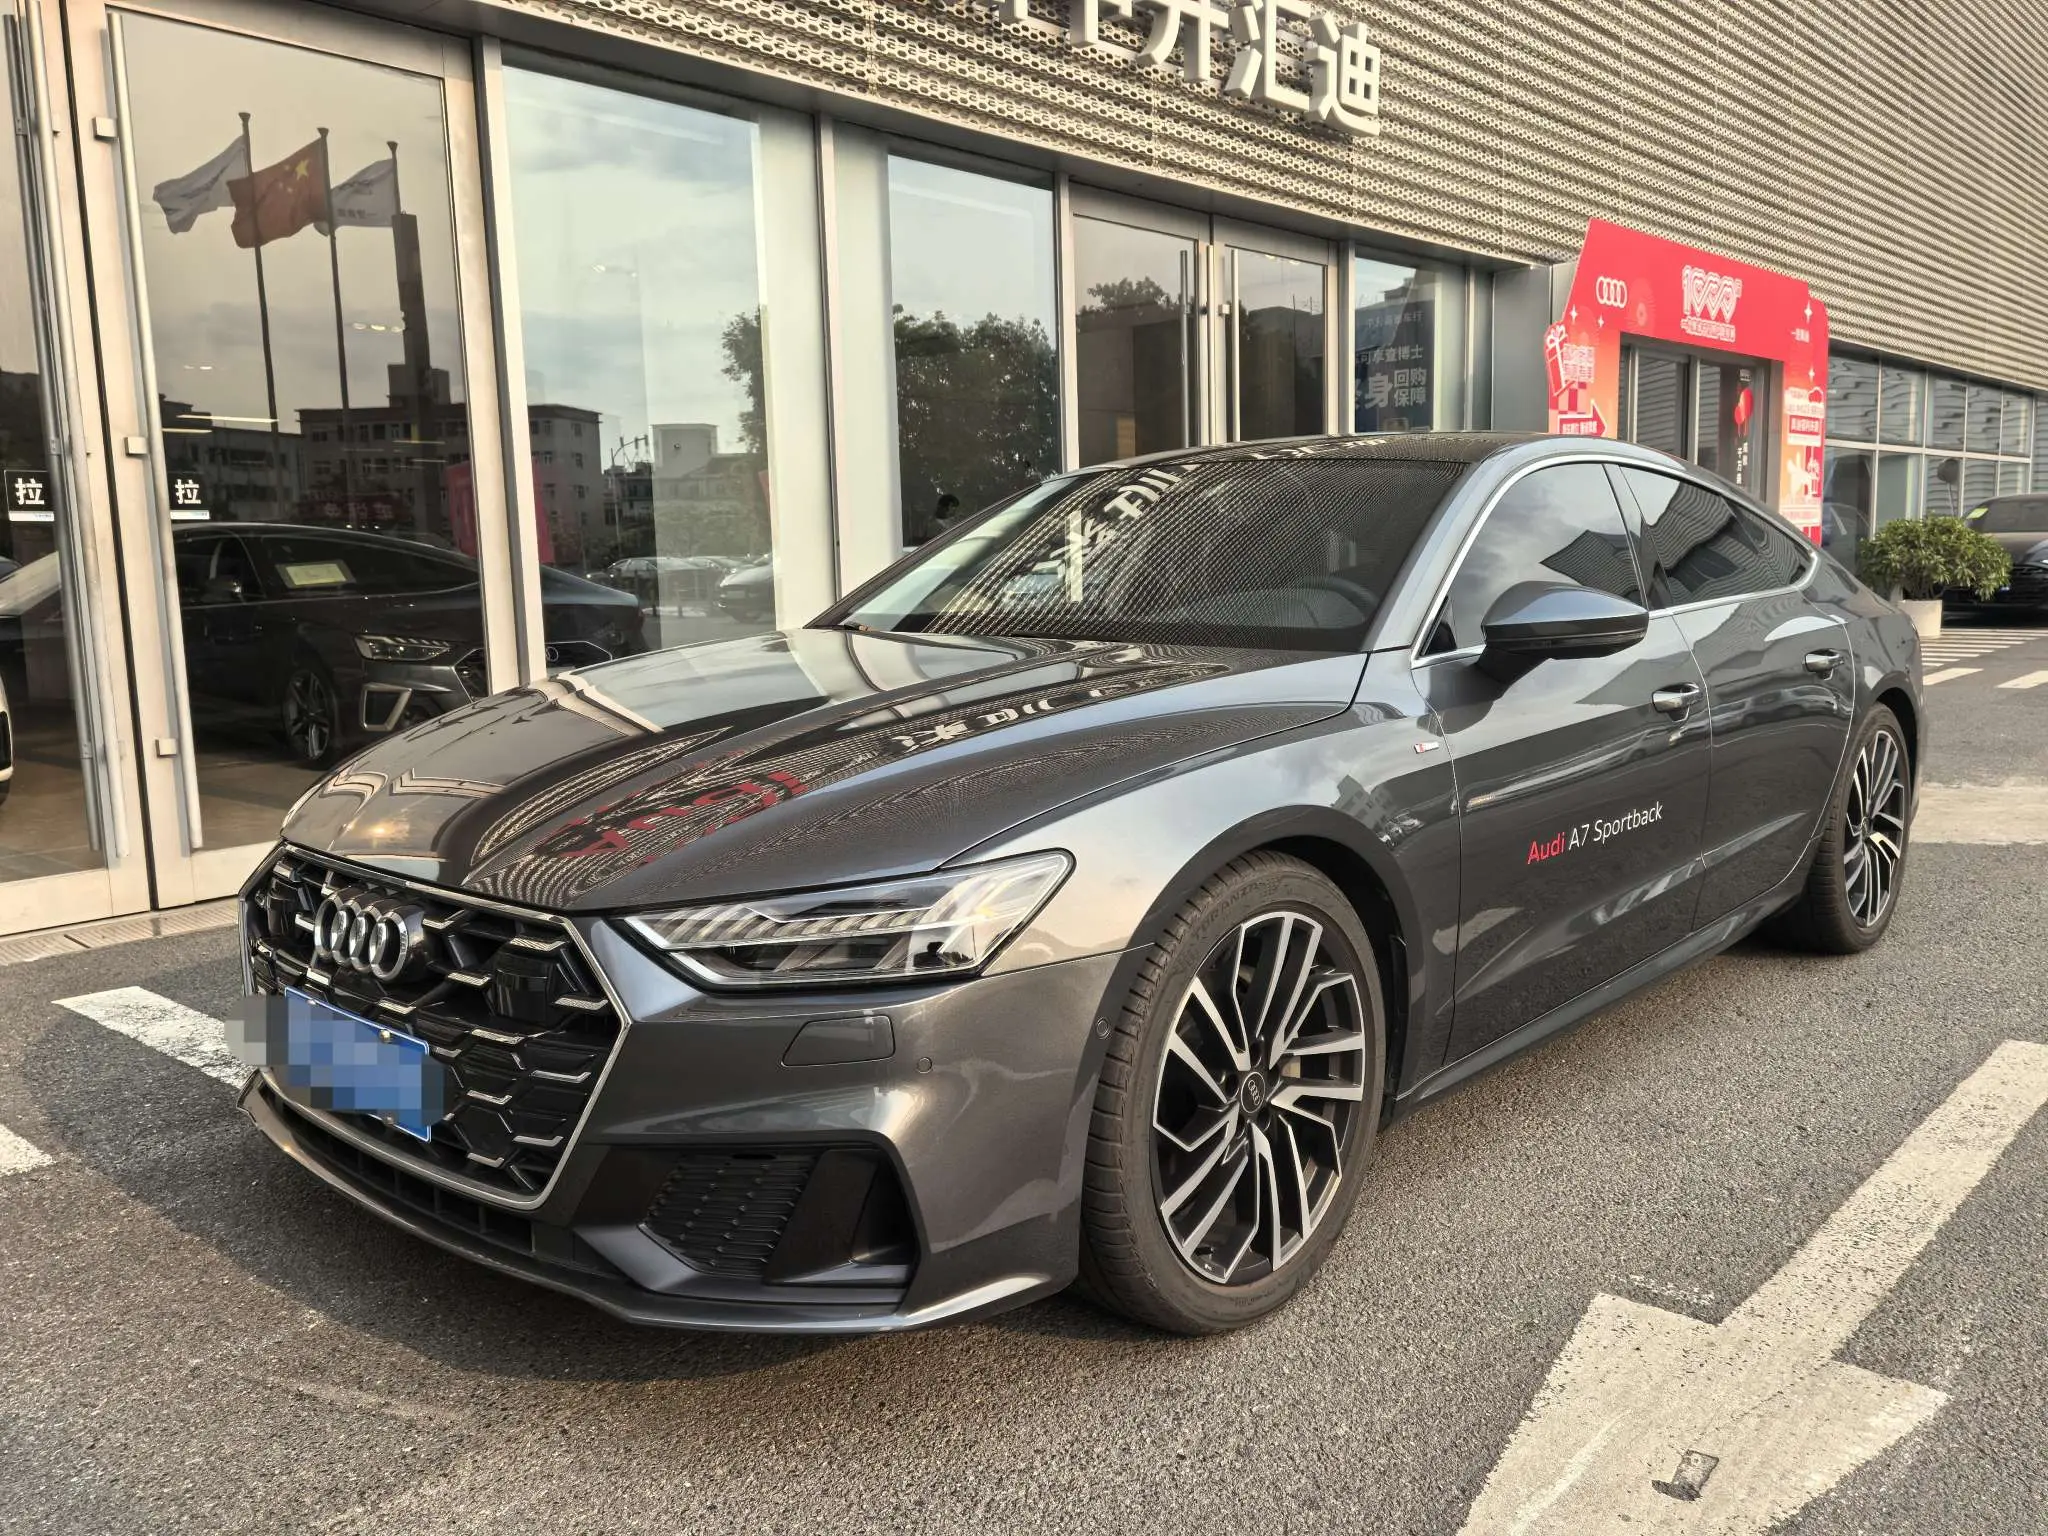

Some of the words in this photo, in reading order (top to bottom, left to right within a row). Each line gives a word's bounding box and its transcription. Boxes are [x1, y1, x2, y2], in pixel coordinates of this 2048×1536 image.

[1394, 368, 1427, 387] 回购
[1394, 387, 1427, 407] 保障
[15, 478, 45, 505] 拉
[174, 479, 202, 505] 拉
[1526, 831, 1567, 864] Audi
[1568, 823, 1590, 850] A7
[1593, 801, 1663, 844] Sportback
